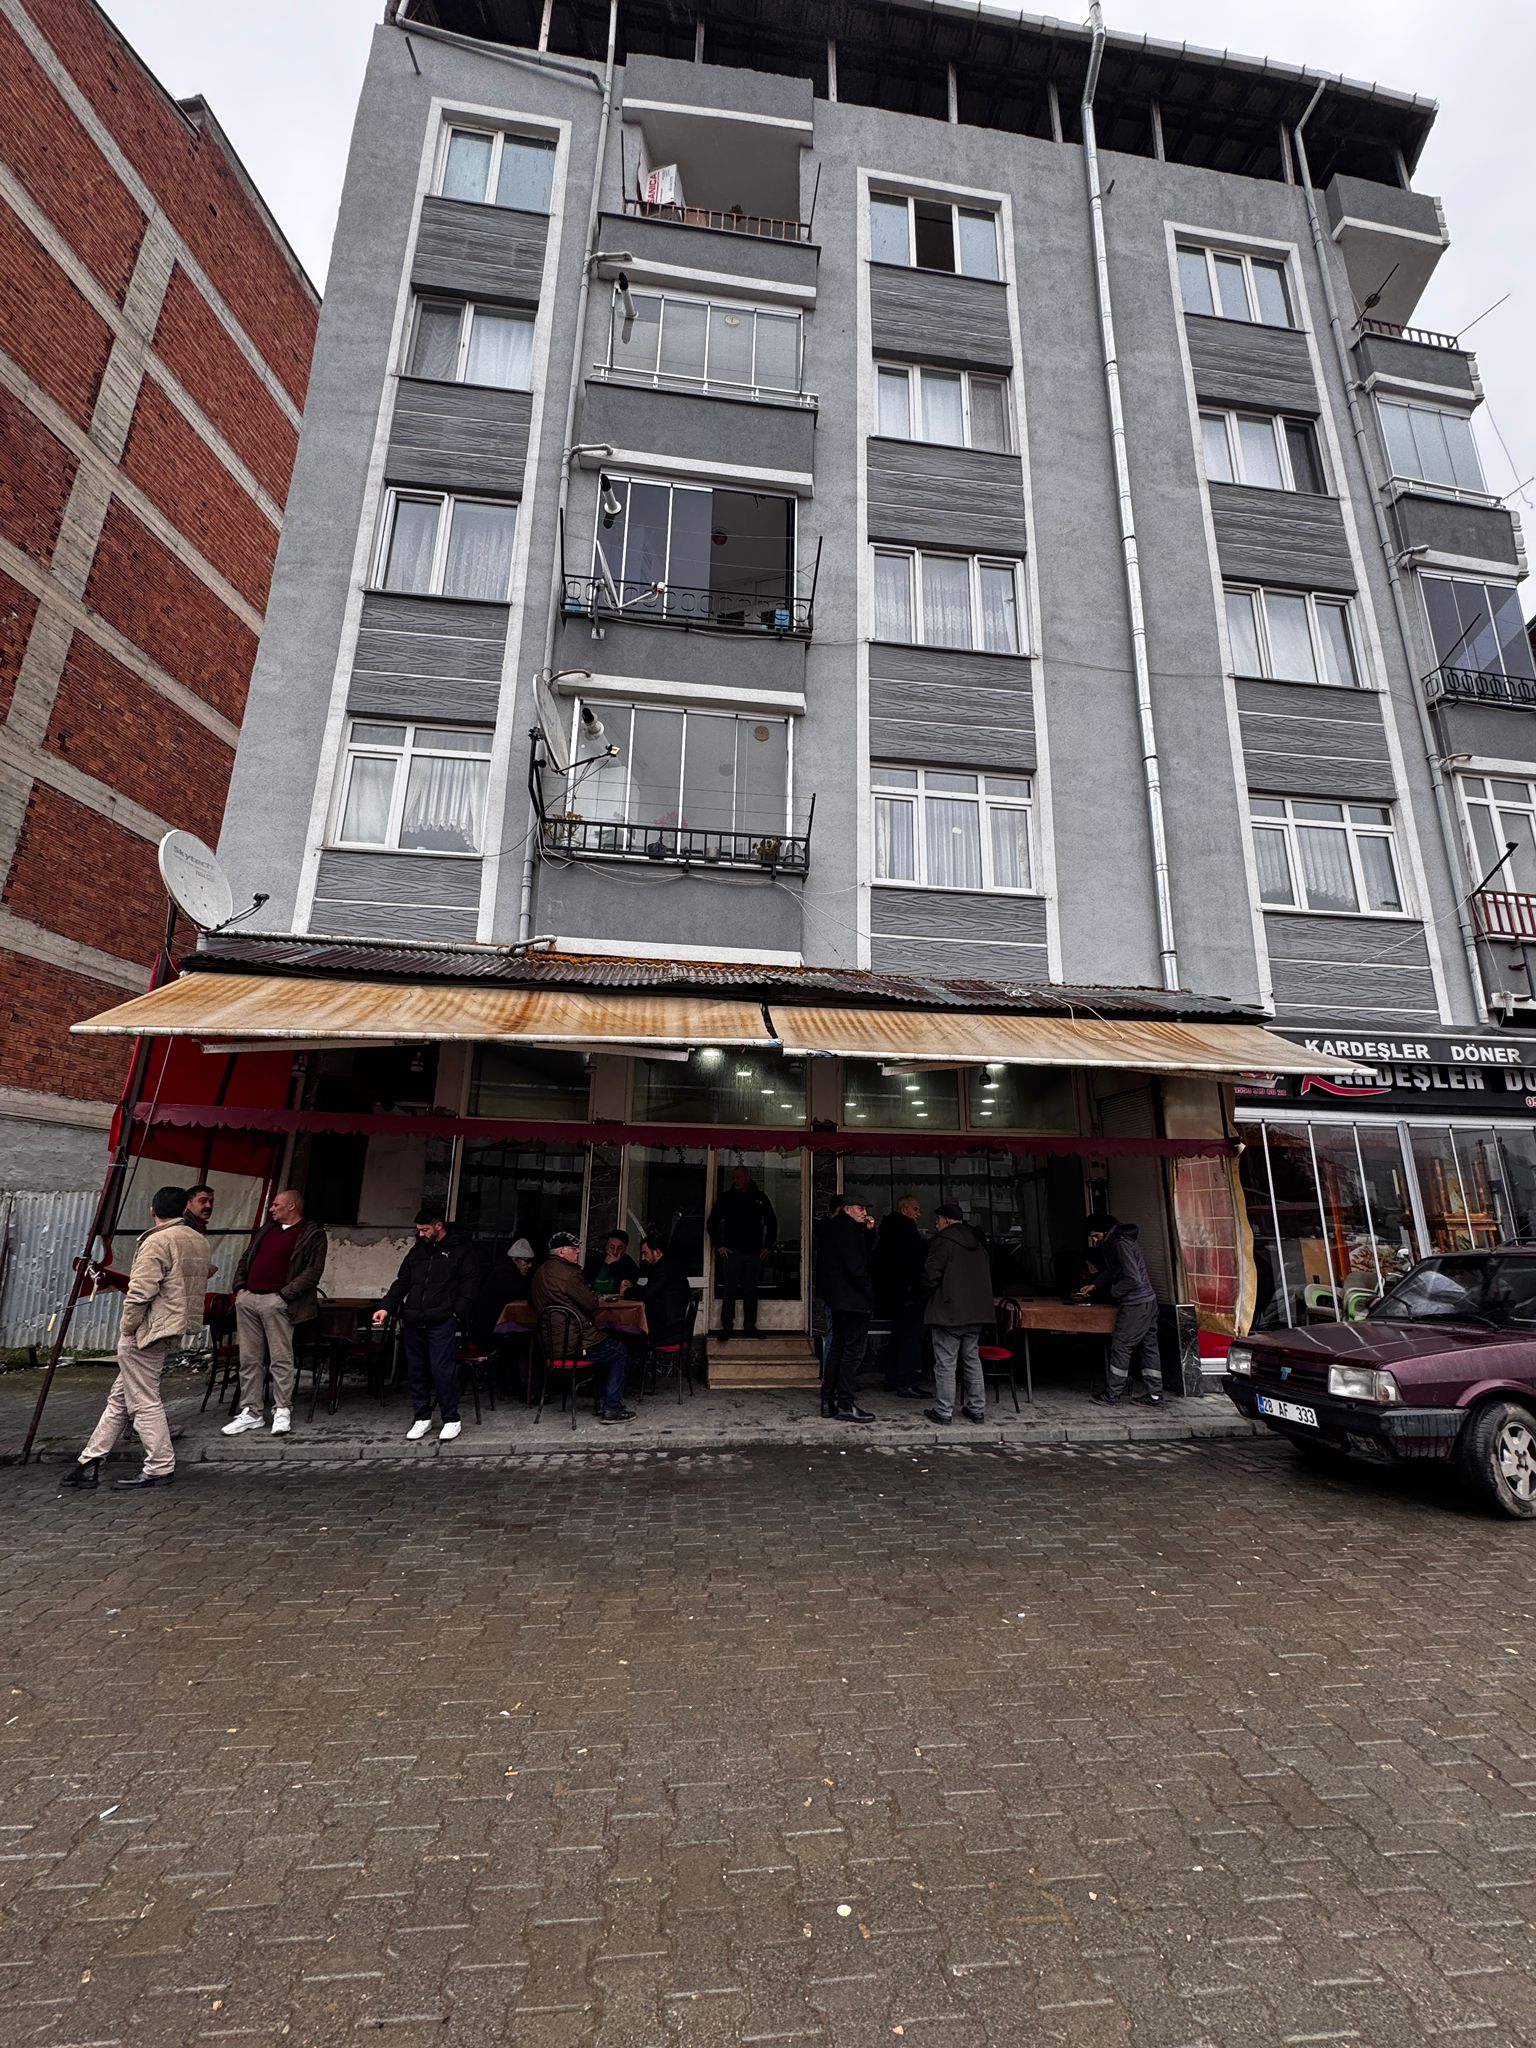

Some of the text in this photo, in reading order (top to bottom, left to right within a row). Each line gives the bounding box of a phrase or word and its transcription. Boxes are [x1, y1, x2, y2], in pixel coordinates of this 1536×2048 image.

[1304, 1039, 1522, 1063] KARDEŞLER DÖNER
[1263, 1398, 1315, 1424] 28 AF 333
